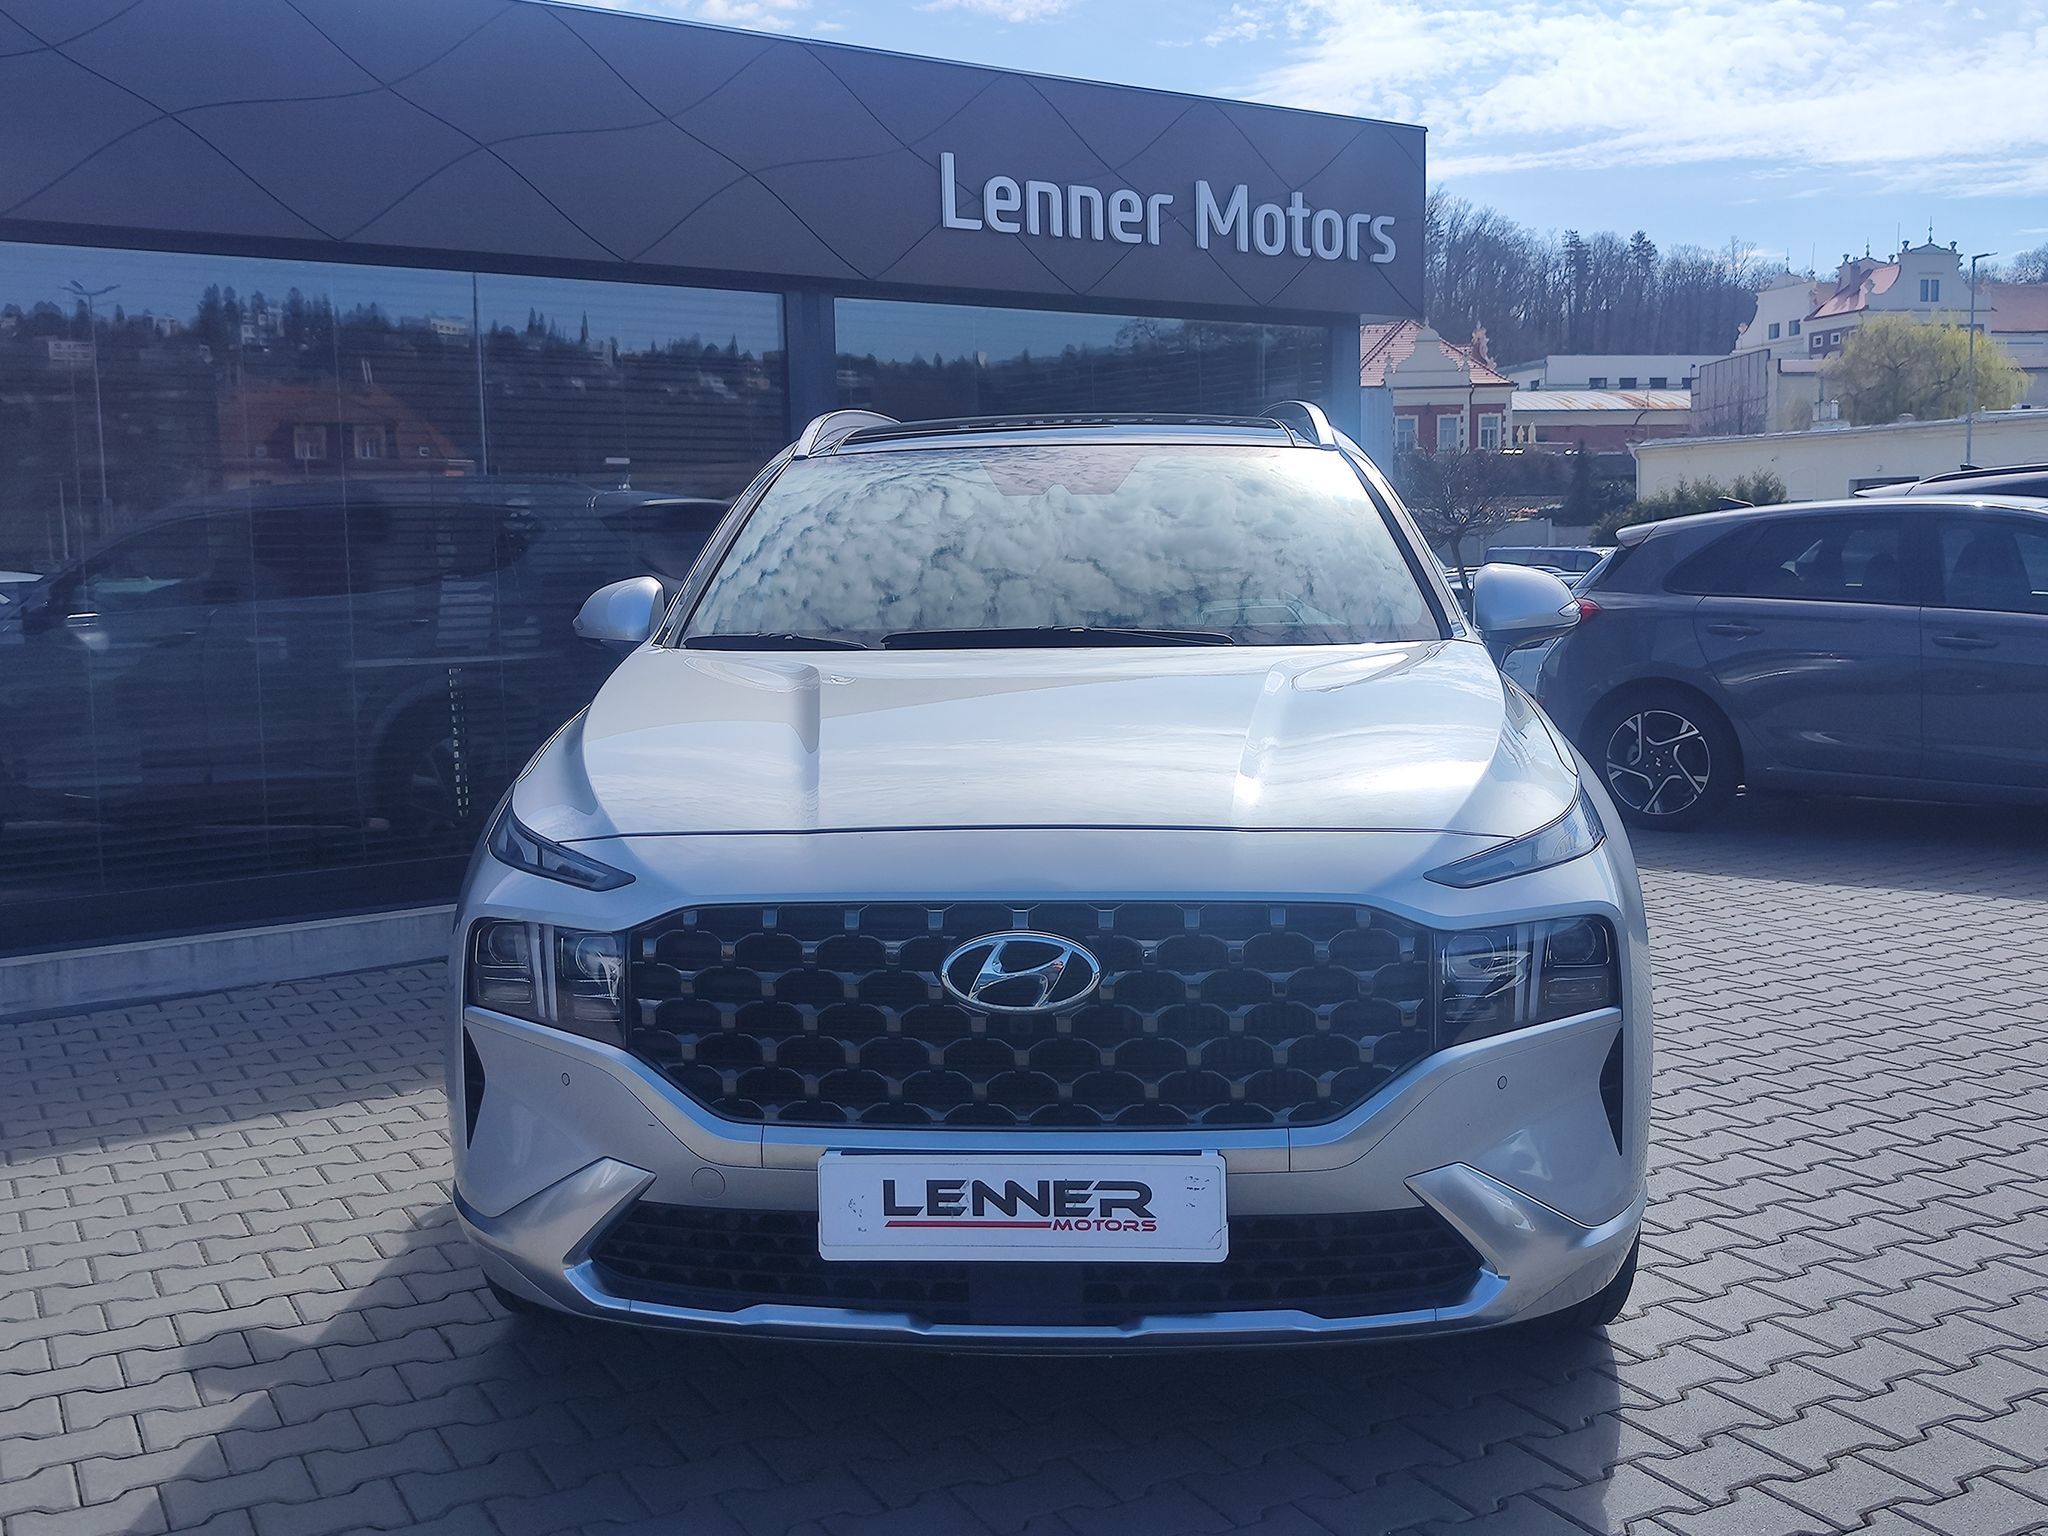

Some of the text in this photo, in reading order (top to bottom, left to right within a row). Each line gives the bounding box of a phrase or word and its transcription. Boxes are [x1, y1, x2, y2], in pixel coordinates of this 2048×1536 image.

[940, 152, 1396, 264] Lenner Motors
[882, 1179, 1156, 1218] LENNER
[1053, 1219, 1157, 1232] MOTORS
